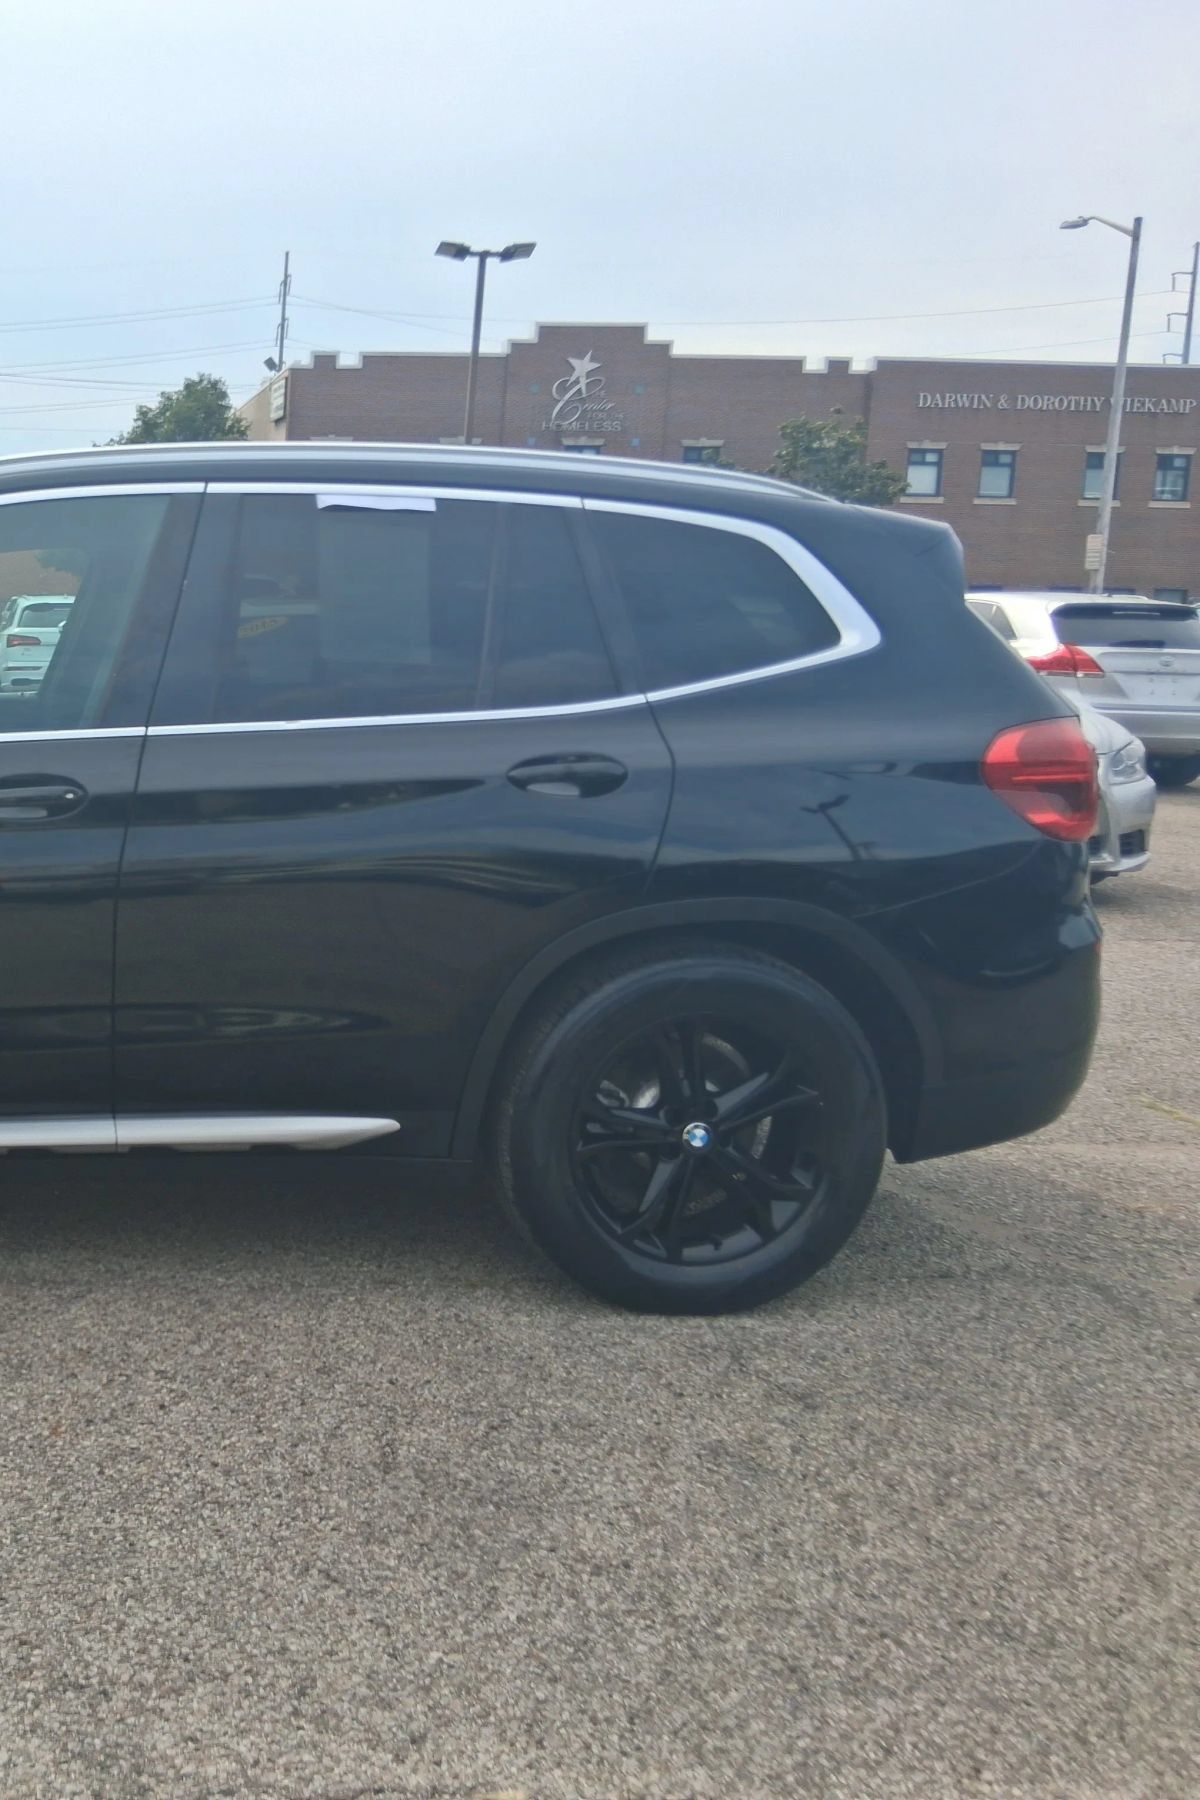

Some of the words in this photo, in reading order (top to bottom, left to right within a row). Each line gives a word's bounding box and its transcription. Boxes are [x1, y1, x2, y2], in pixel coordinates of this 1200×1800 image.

[918, 392, 994, 409] DARWIN
[997, 394, 1010, 409] &
[1016, 394, 1104, 411] DOROTHY
[542, 421, 621, 431] HOMELESS
